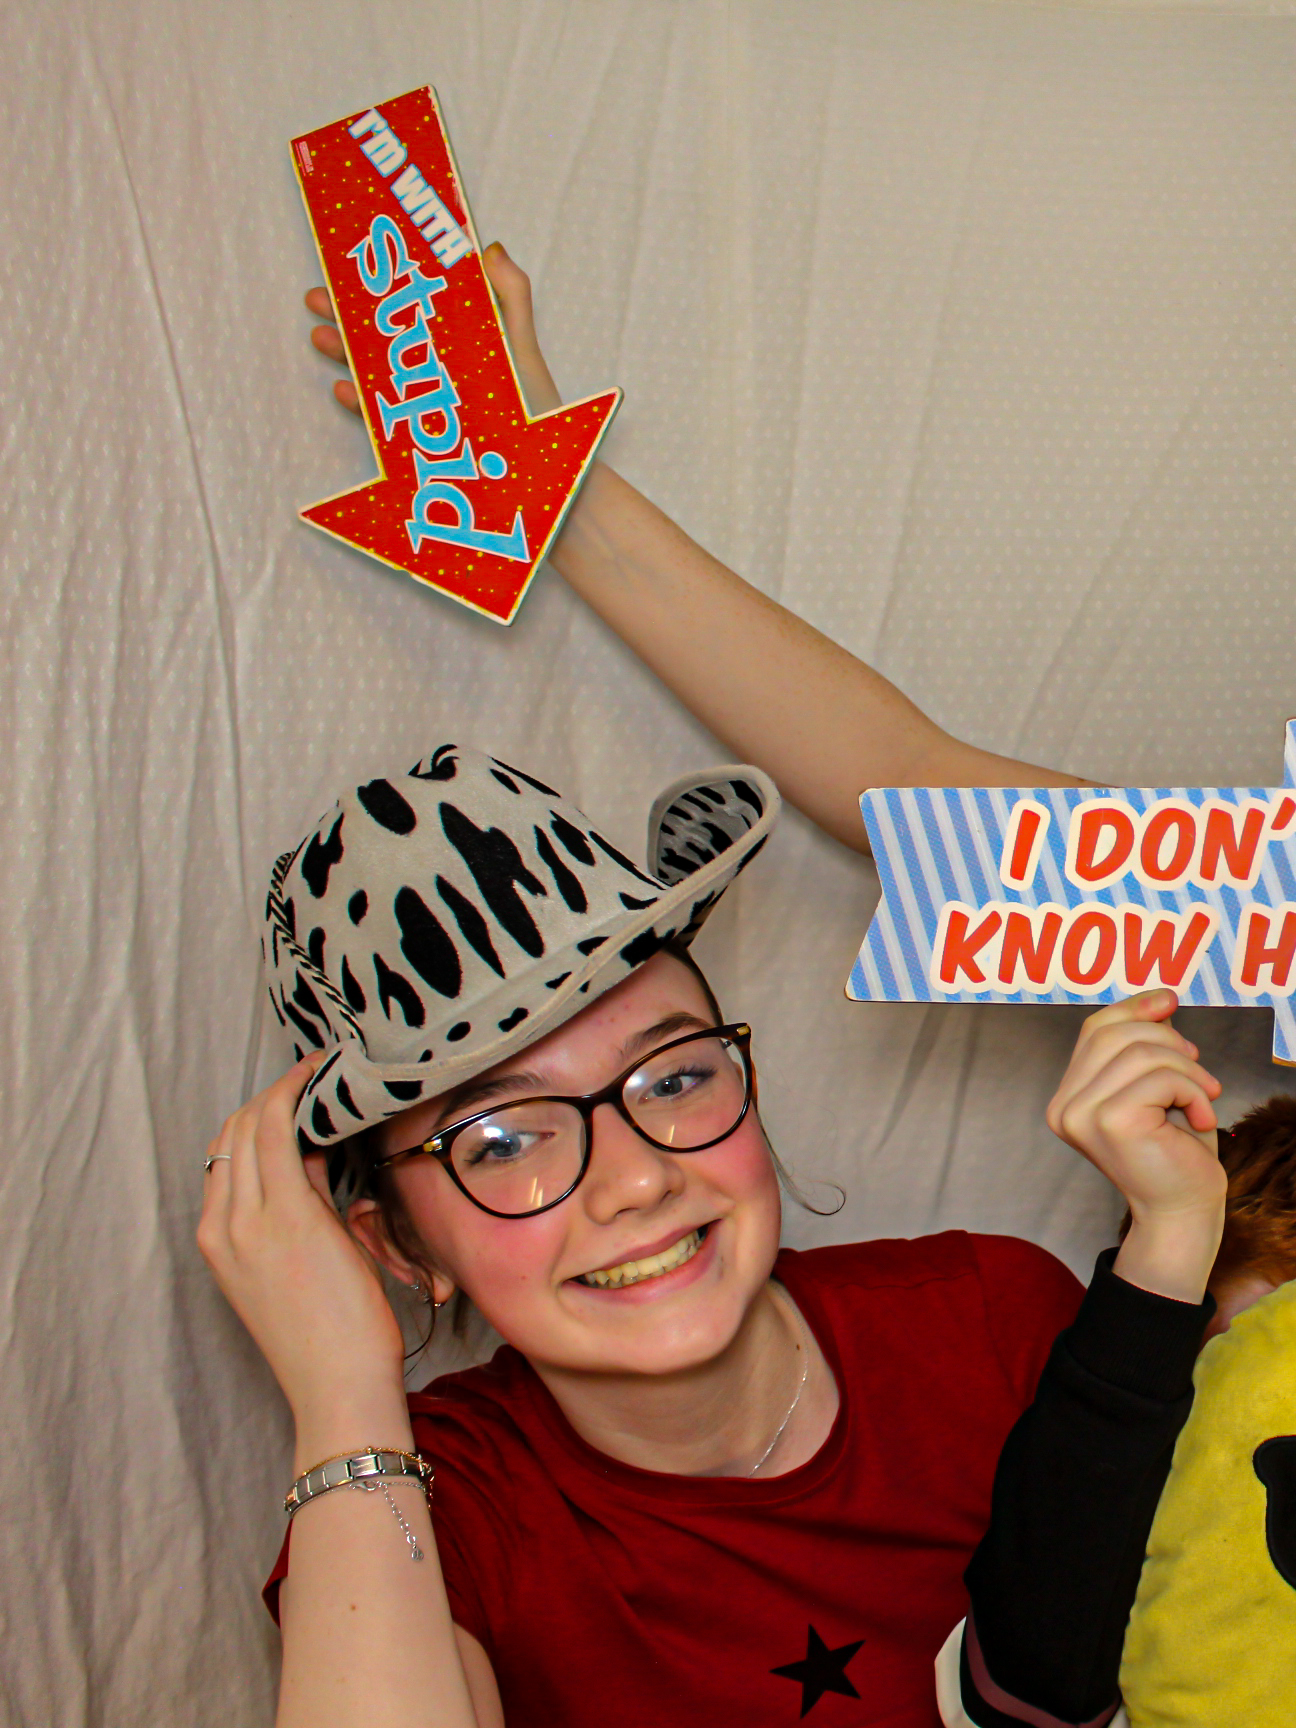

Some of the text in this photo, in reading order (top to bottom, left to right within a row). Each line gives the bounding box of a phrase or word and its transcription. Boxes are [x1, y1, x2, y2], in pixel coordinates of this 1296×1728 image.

[390, 163, 474, 269] WITH
[1008, 805, 1043, 883] I
[938, 910, 1210, 987] KNOW
